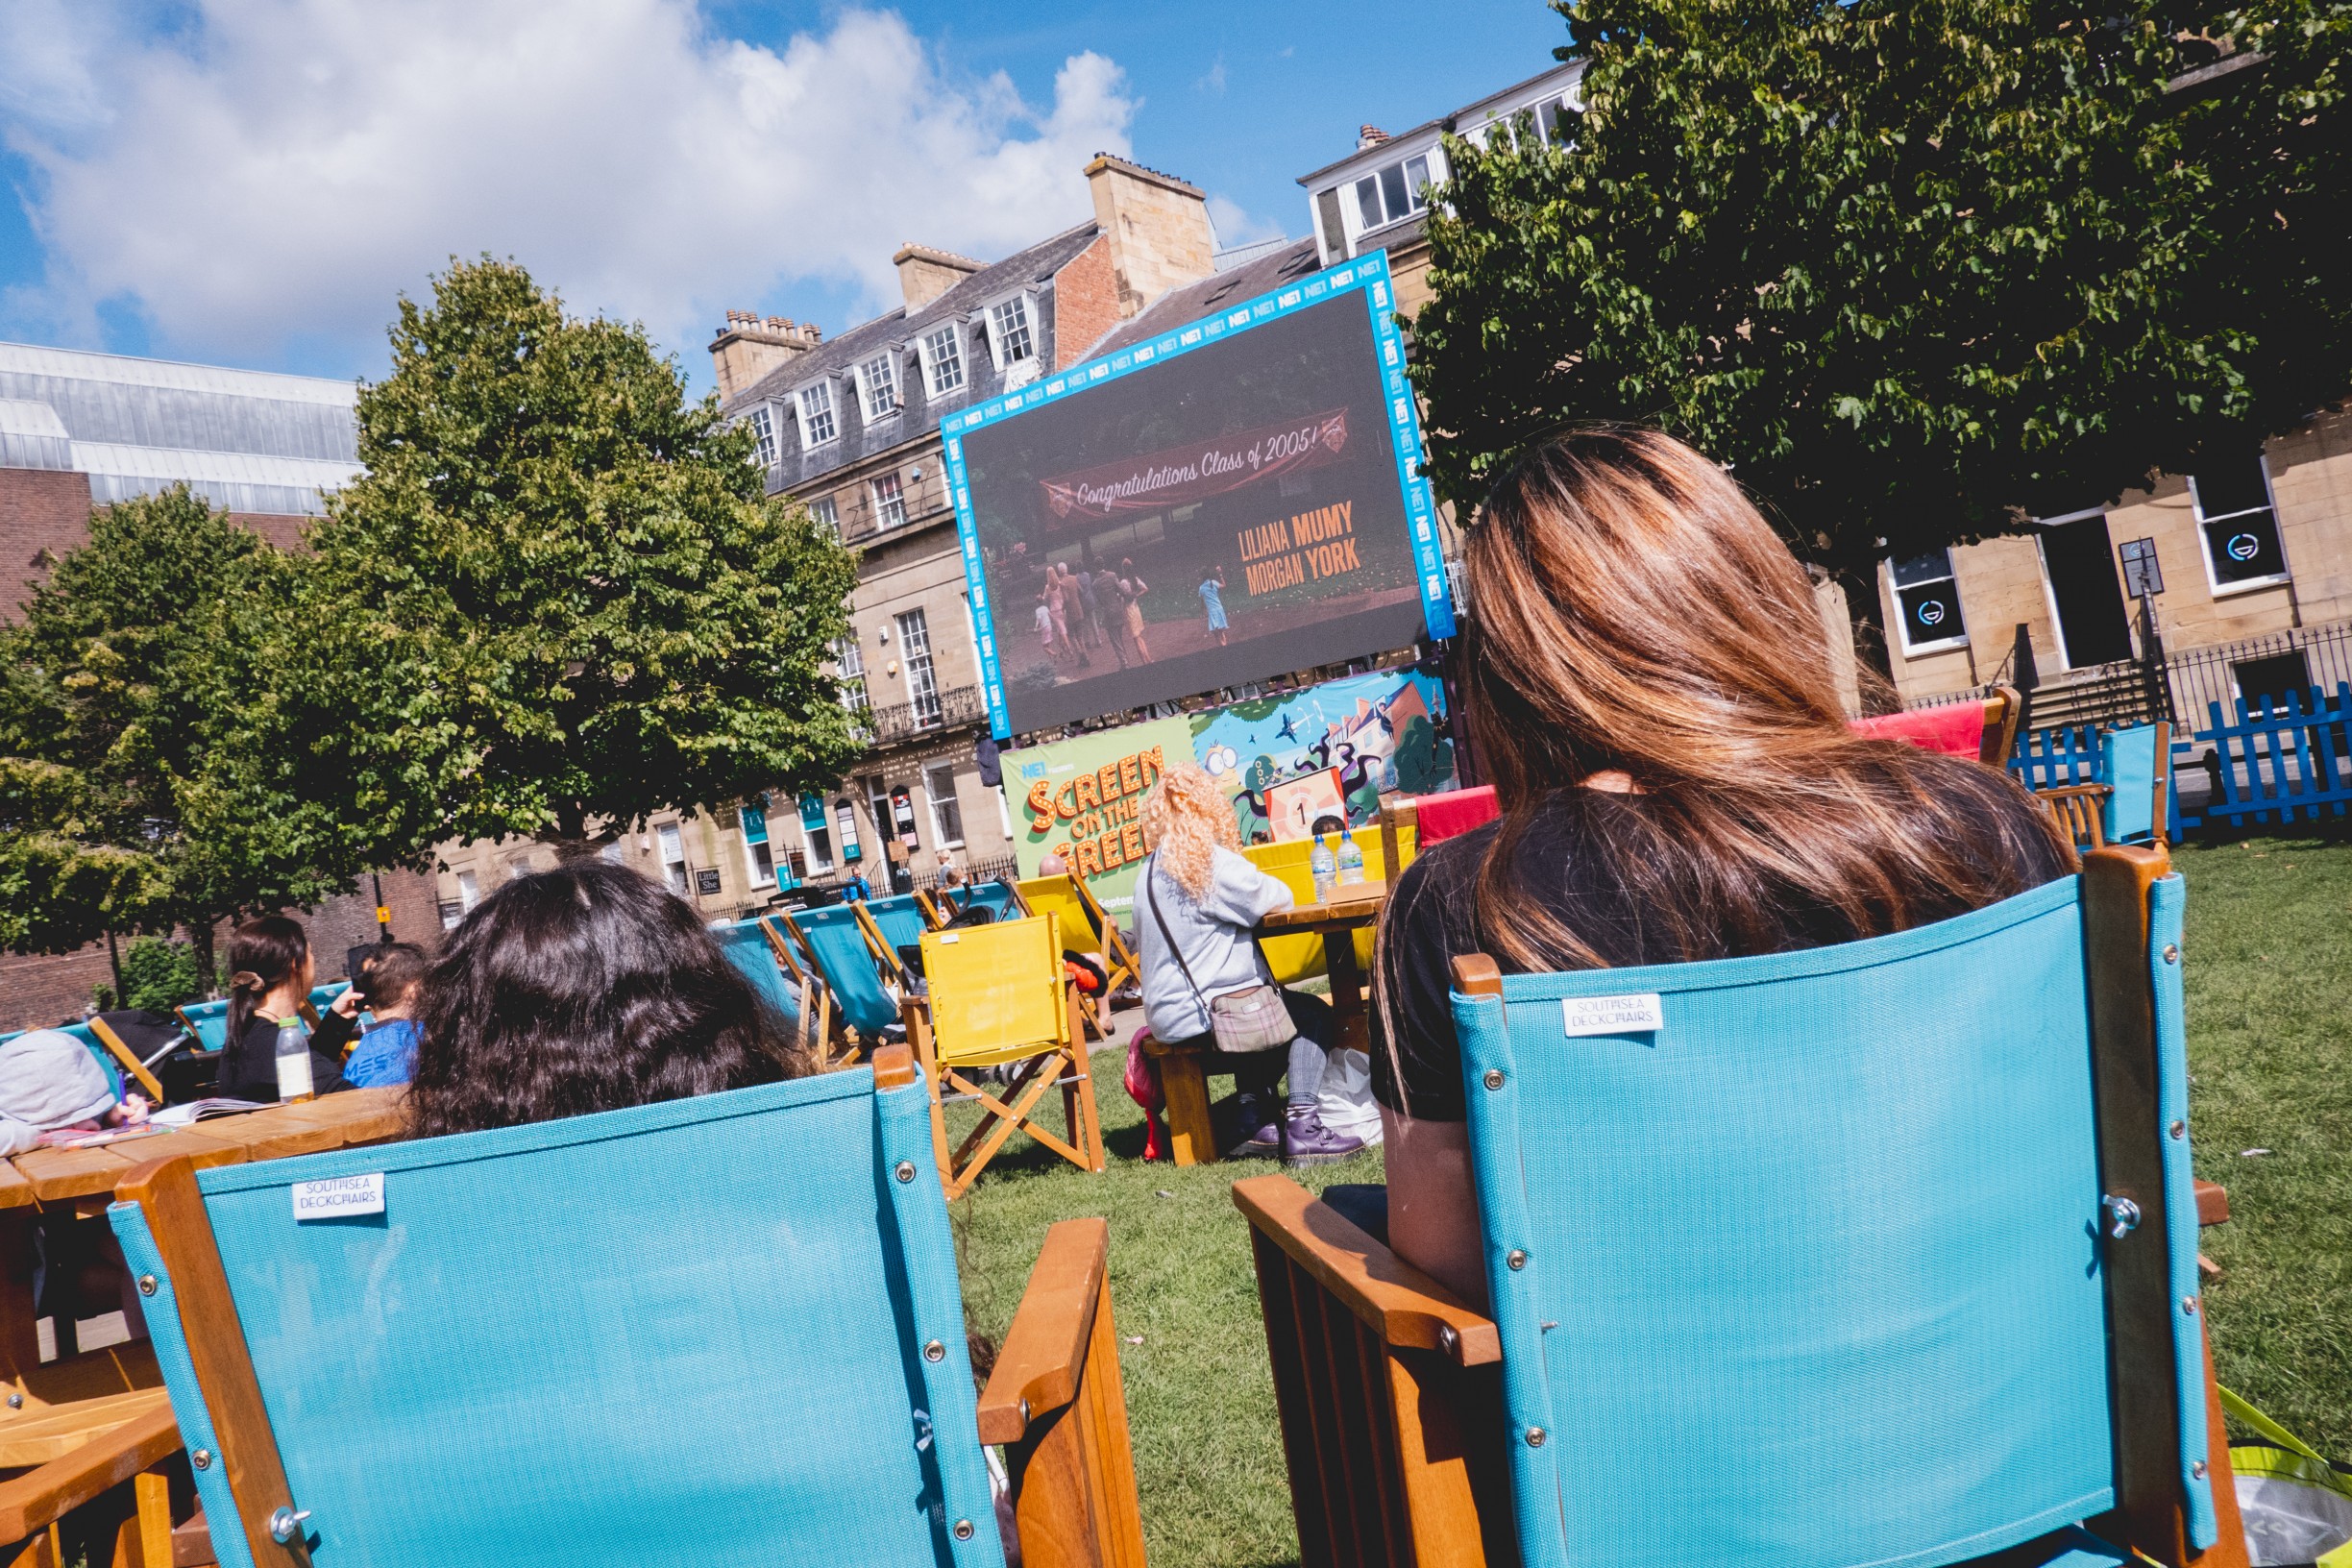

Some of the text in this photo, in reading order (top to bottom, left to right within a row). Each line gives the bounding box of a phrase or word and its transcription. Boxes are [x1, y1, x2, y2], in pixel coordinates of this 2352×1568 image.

[944, 260, 1381, 432] NE1 NE1 NE1 NE1 NE1 NE1 NE1 NE1 NE1 NE1 NE1 NE1 NE1 NE1 NE1 NE1 NE1 NE1 NE1
[1077, 463, 1198, 512] Congratulations
[1202, 451, 1244, 477] Class
[1248, 441, 1261, 470] of
[1264, 426, 1317, 461] 2005!
[1238, 500, 1352, 562] LILIANA MUMY
[1246, 537, 1360, 597] MORGAN YORK
[1021, 761, 1046, 779] NE1
[1028, 745, 1164, 833] SCREEN
[1071, 796, 1139, 839] ON THE
[1297, 802, 1306, 825] 1
[698, 871, 719, 882] Little
[1097, 895, 1135, 909] Septem
[1577, 998, 1644, 1013] SOUTHSEA
[1573, 1011, 1654, 1027] DECKCHAIRS
[346, 1054, 388, 1076] MES
[306, 1178, 370, 1193] SOUTHSEA
[301, 1191, 376, 1209] DECKCHAIRS
